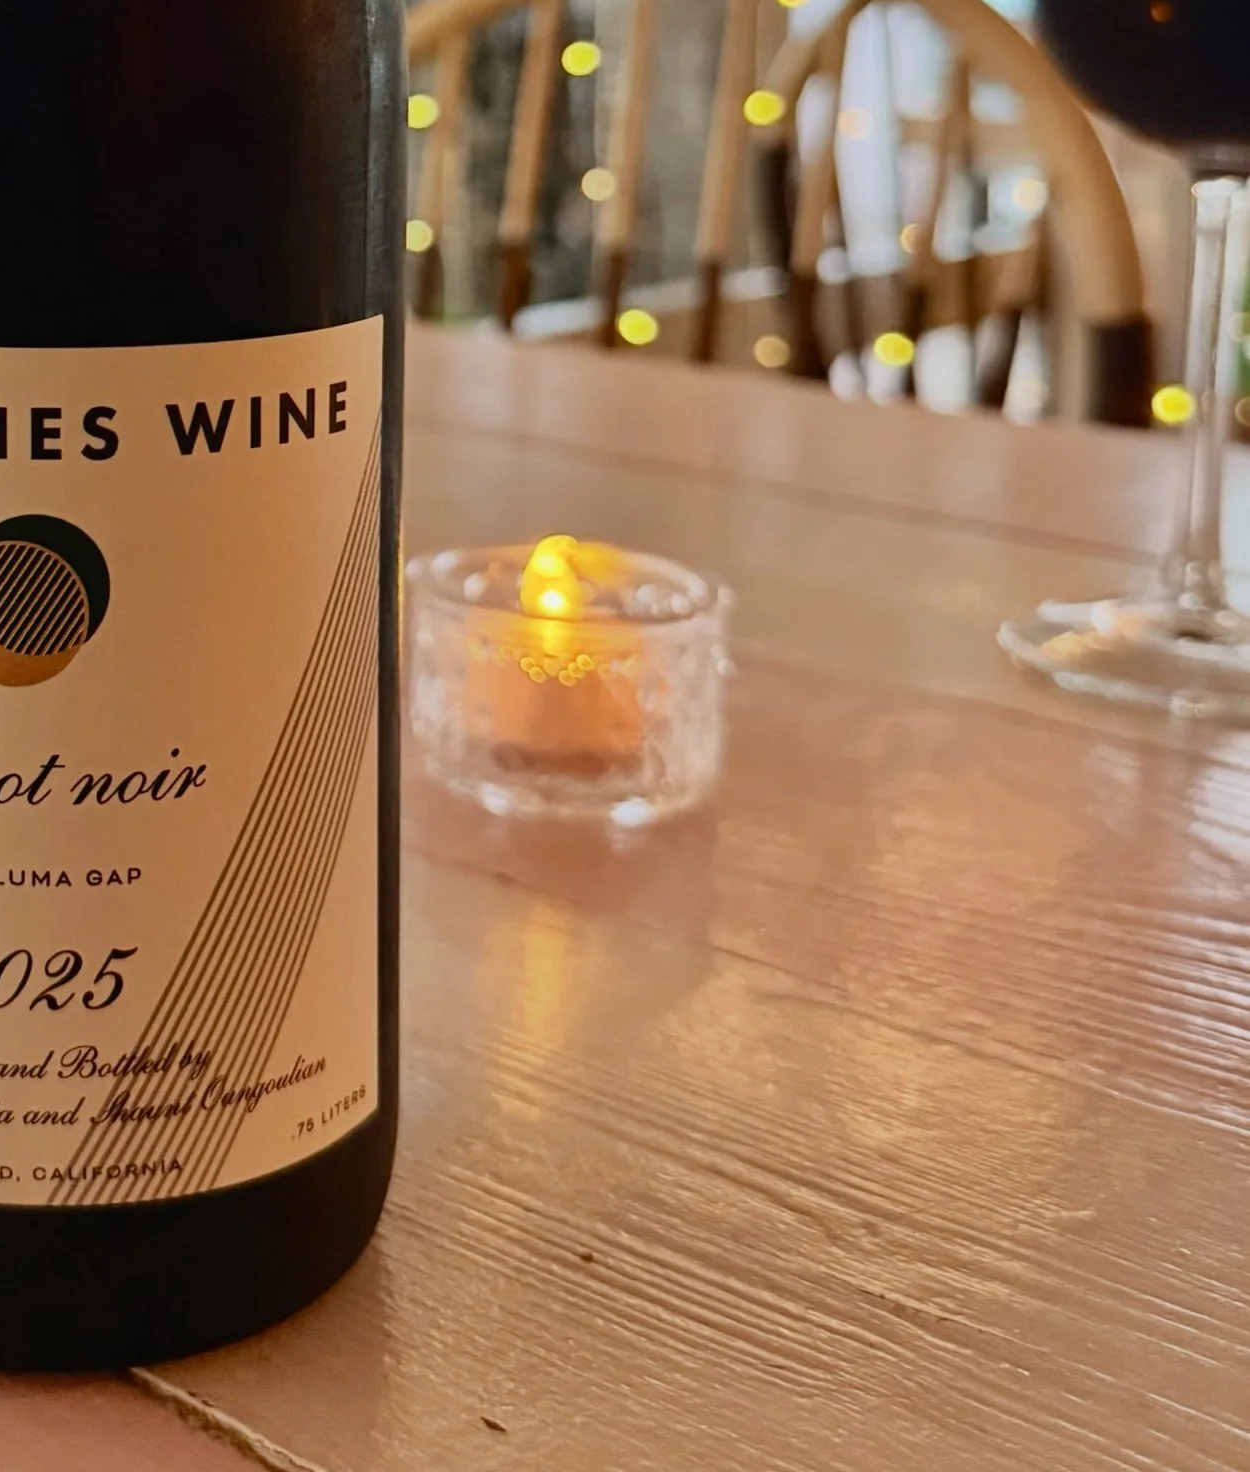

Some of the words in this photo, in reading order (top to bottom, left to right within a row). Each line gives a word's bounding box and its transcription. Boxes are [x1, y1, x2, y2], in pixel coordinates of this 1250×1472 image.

[165, 380, 348, 455] WINE
[70, 747, 205, 806] noir
[86, 867, 142, 887] GAP
[58, 1044, 171, 1079] Bottled
[179, 1040, 212, 1079] by
[22, 1097, 79, 1125] and
[90, 1090, 193, 1126] Shaunt
[200, 1054, 327, 1113] Oungoulian
[321, 1084, 367, 1126] LITERS
[32, 1158, 183, 1181] CALIFORNIA
